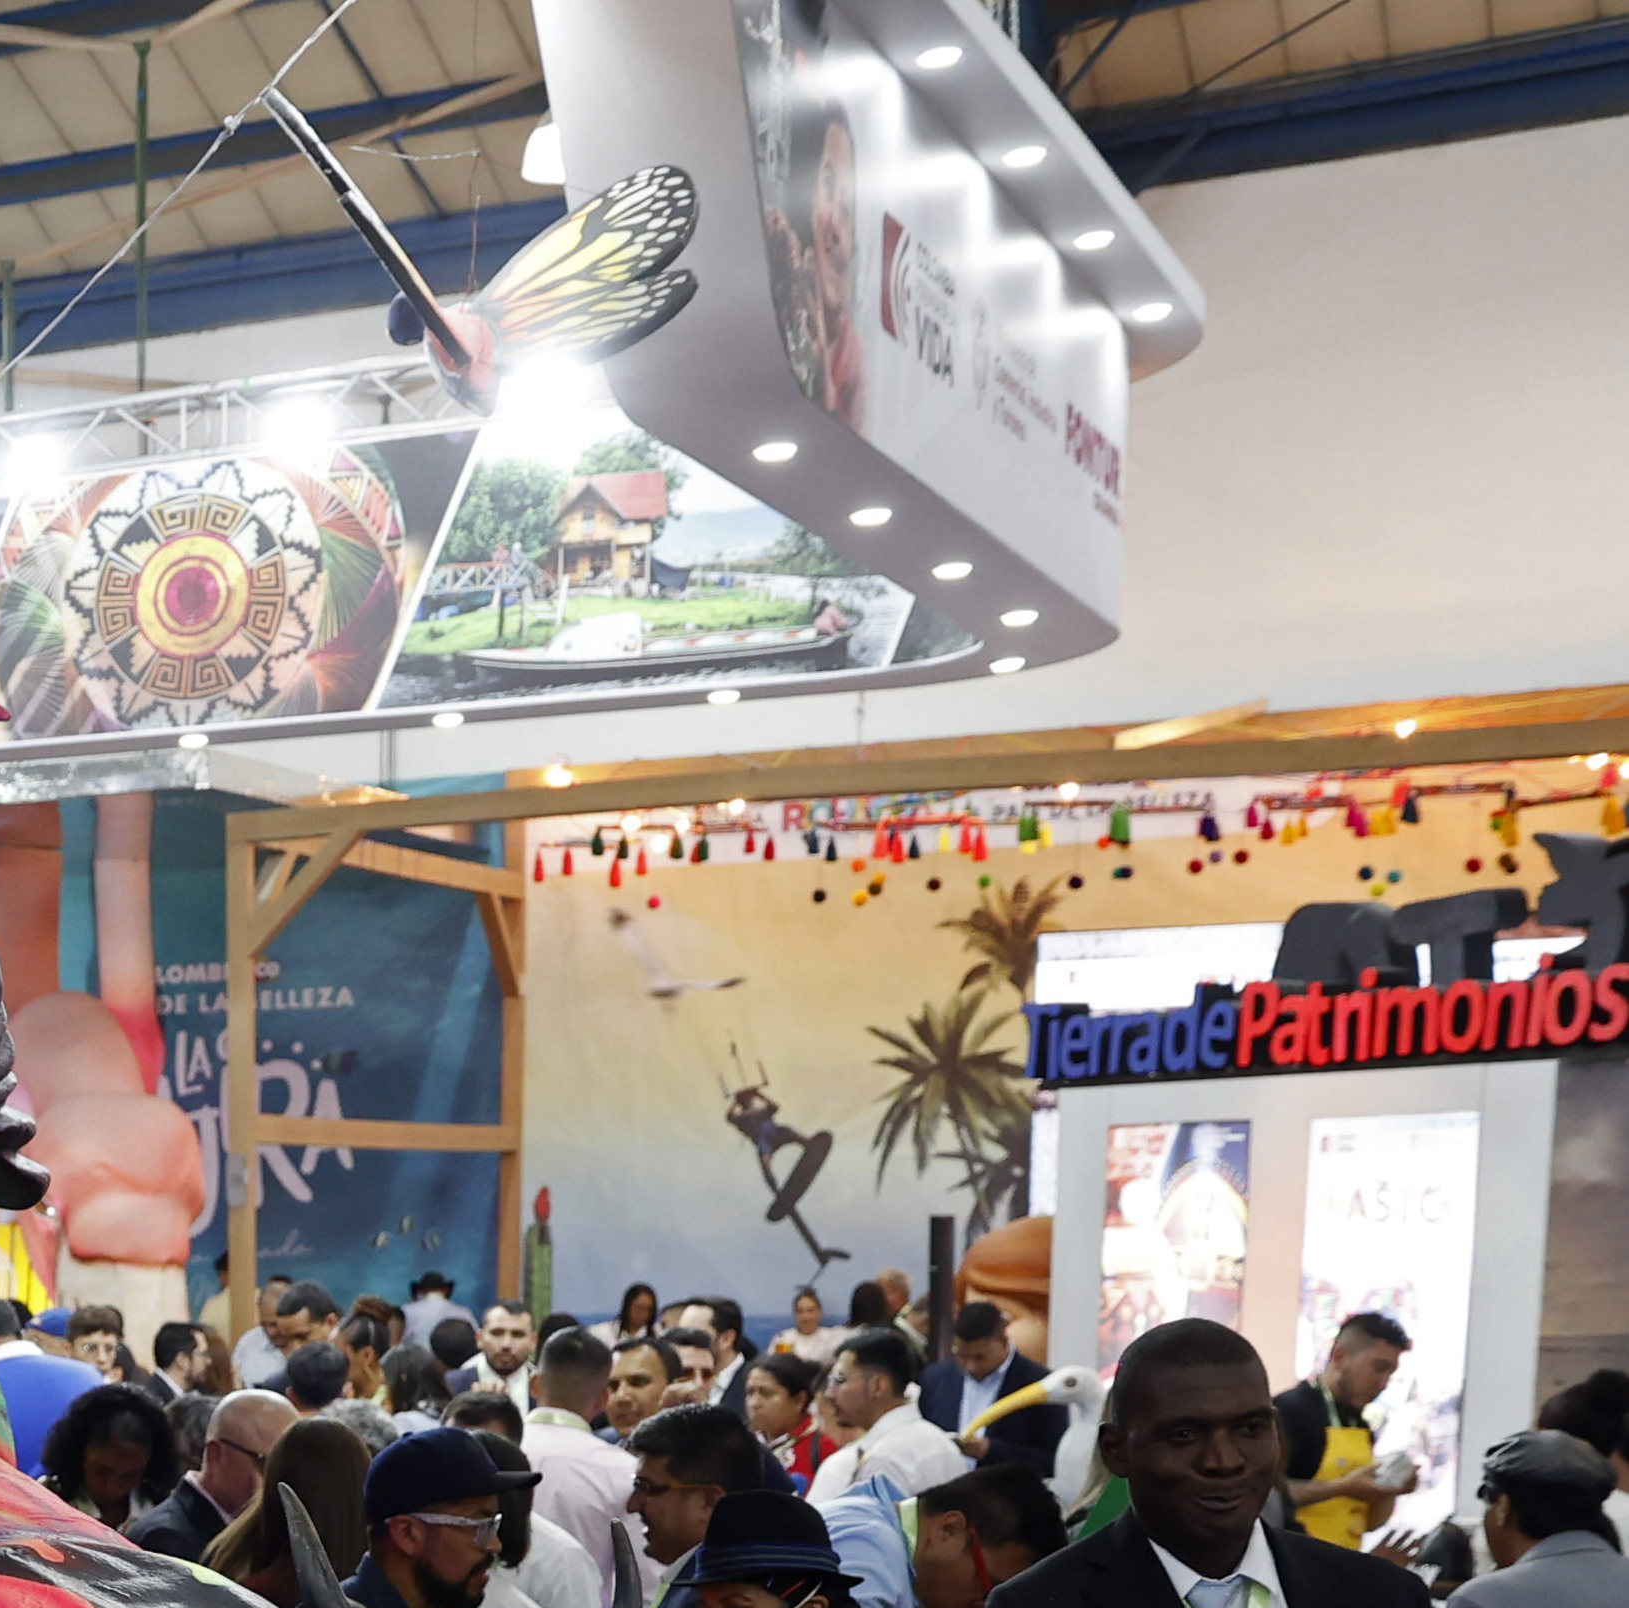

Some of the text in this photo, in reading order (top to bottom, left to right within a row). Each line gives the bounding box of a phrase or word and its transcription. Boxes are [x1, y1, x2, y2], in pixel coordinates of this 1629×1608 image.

[257, 985, 356, 1011] ELLEZA
[1237, 953, 1629, 1068] Patrimonios
[175, 1030, 213, 1097] LA
